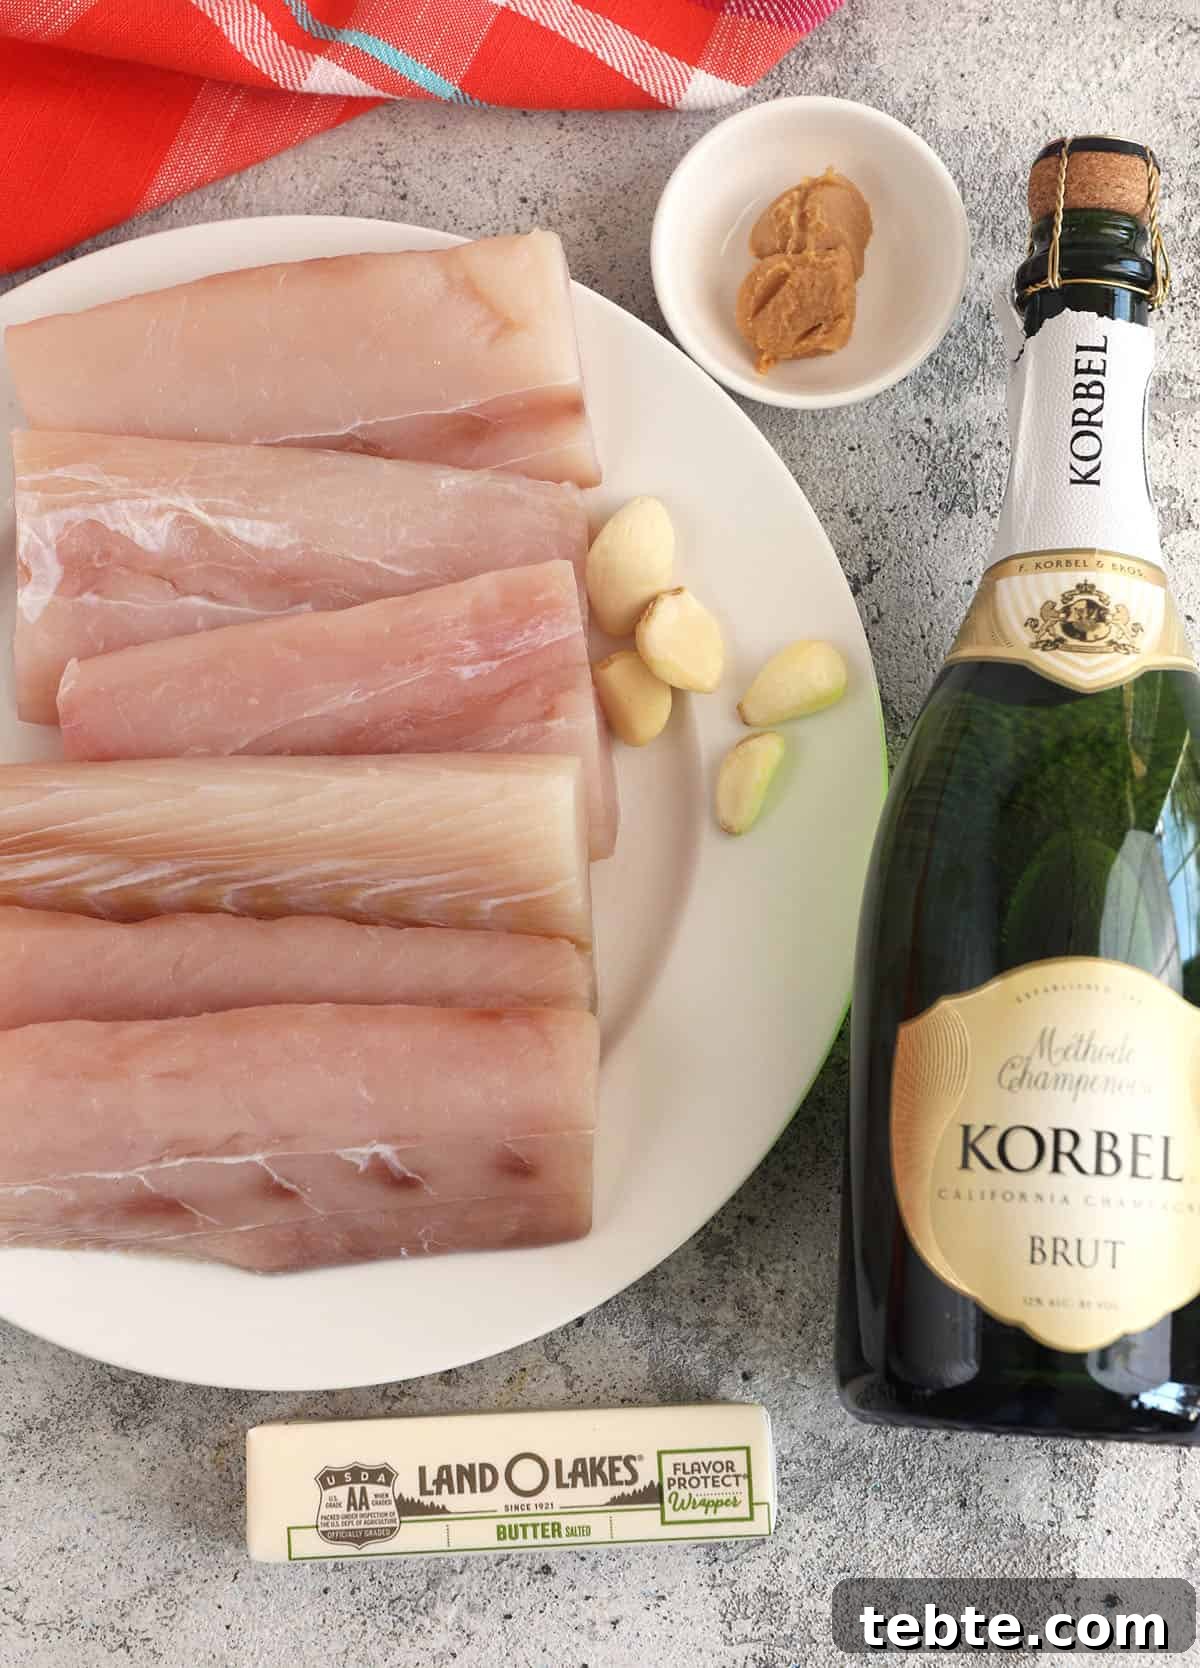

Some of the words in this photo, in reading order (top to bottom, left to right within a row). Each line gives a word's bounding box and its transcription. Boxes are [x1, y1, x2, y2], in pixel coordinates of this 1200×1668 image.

[1069, 335, 1108, 486] KORBEL
[1034, 560, 1089, 571] KORBEL
[957, 1123, 1185, 1184] KORBEL
[936, 1187, 1071, 1207] CALIFORNIA
[1028, 1234, 1127, 1271] BRUT
[326, 1471, 386, 1486] USDA
[418, 1462, 499, 1497] LAND
[504, 1452, 549, 1498] O
[672, 1459, 737, 1476] FLAVOR
[346, 1485, 370, 1512] AA
[504, 1503, 531, 1513] SINCE
[534, 1502, 555, 1511] 1921
[669, 1491, 742, 1515] Wrapper
[496, 1521, 564, 1542] BUTTER
[565, 1524, 592, 1538] SALTED
